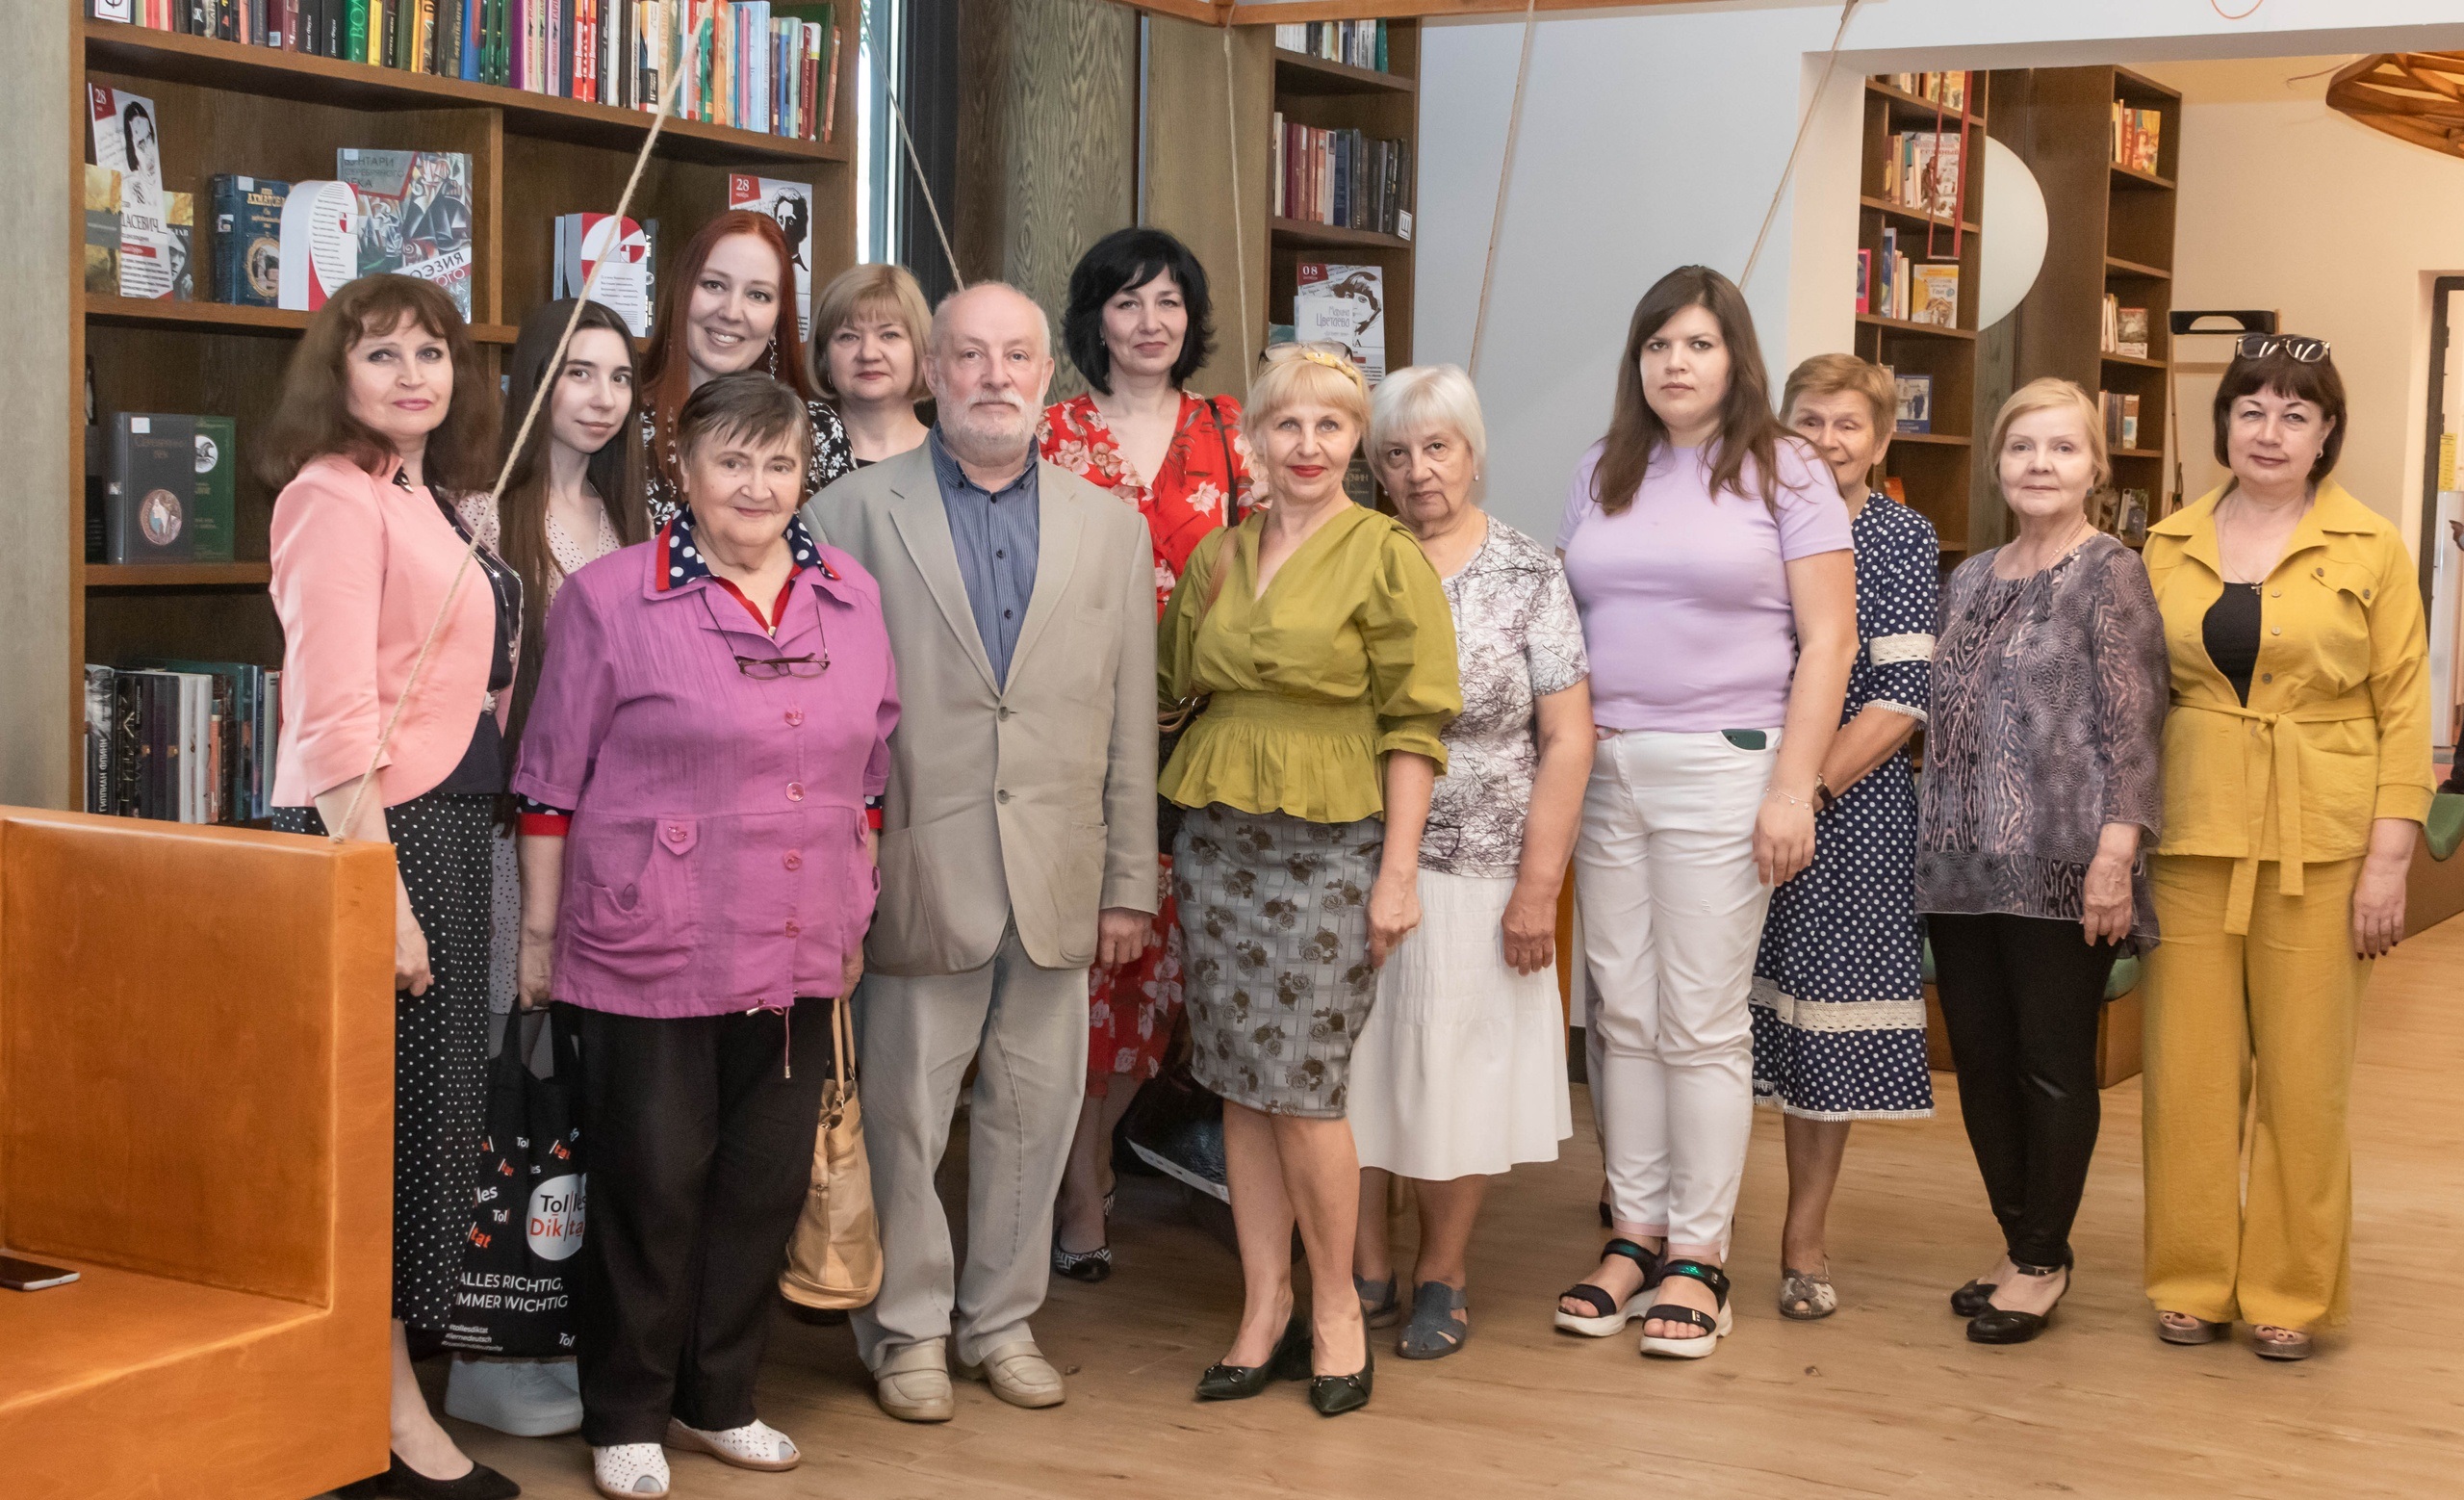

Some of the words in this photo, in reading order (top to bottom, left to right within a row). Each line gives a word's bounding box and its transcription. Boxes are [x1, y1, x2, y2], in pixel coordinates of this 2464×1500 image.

[94, 88, 106, 104] 28
[736, 178, 749, 192] 28
[1303, 266, 1318, 275] 08
[1316, 313, 1350, 328] Цветаева
[99, 737, 108, 770] ФЛИНН
[517, 1137, 529, 1149] Tol
[477, 1186, 499, 1203] les
[493, 1209, 508, 1223] Tol
[460, 1272, 500, 1288] ALLES
[502, 1275, 563, 1292] RICHTIG,
[504, 1294, 569, 1312] WICHTIG
[558, 1332, 577, 1347] Tol
